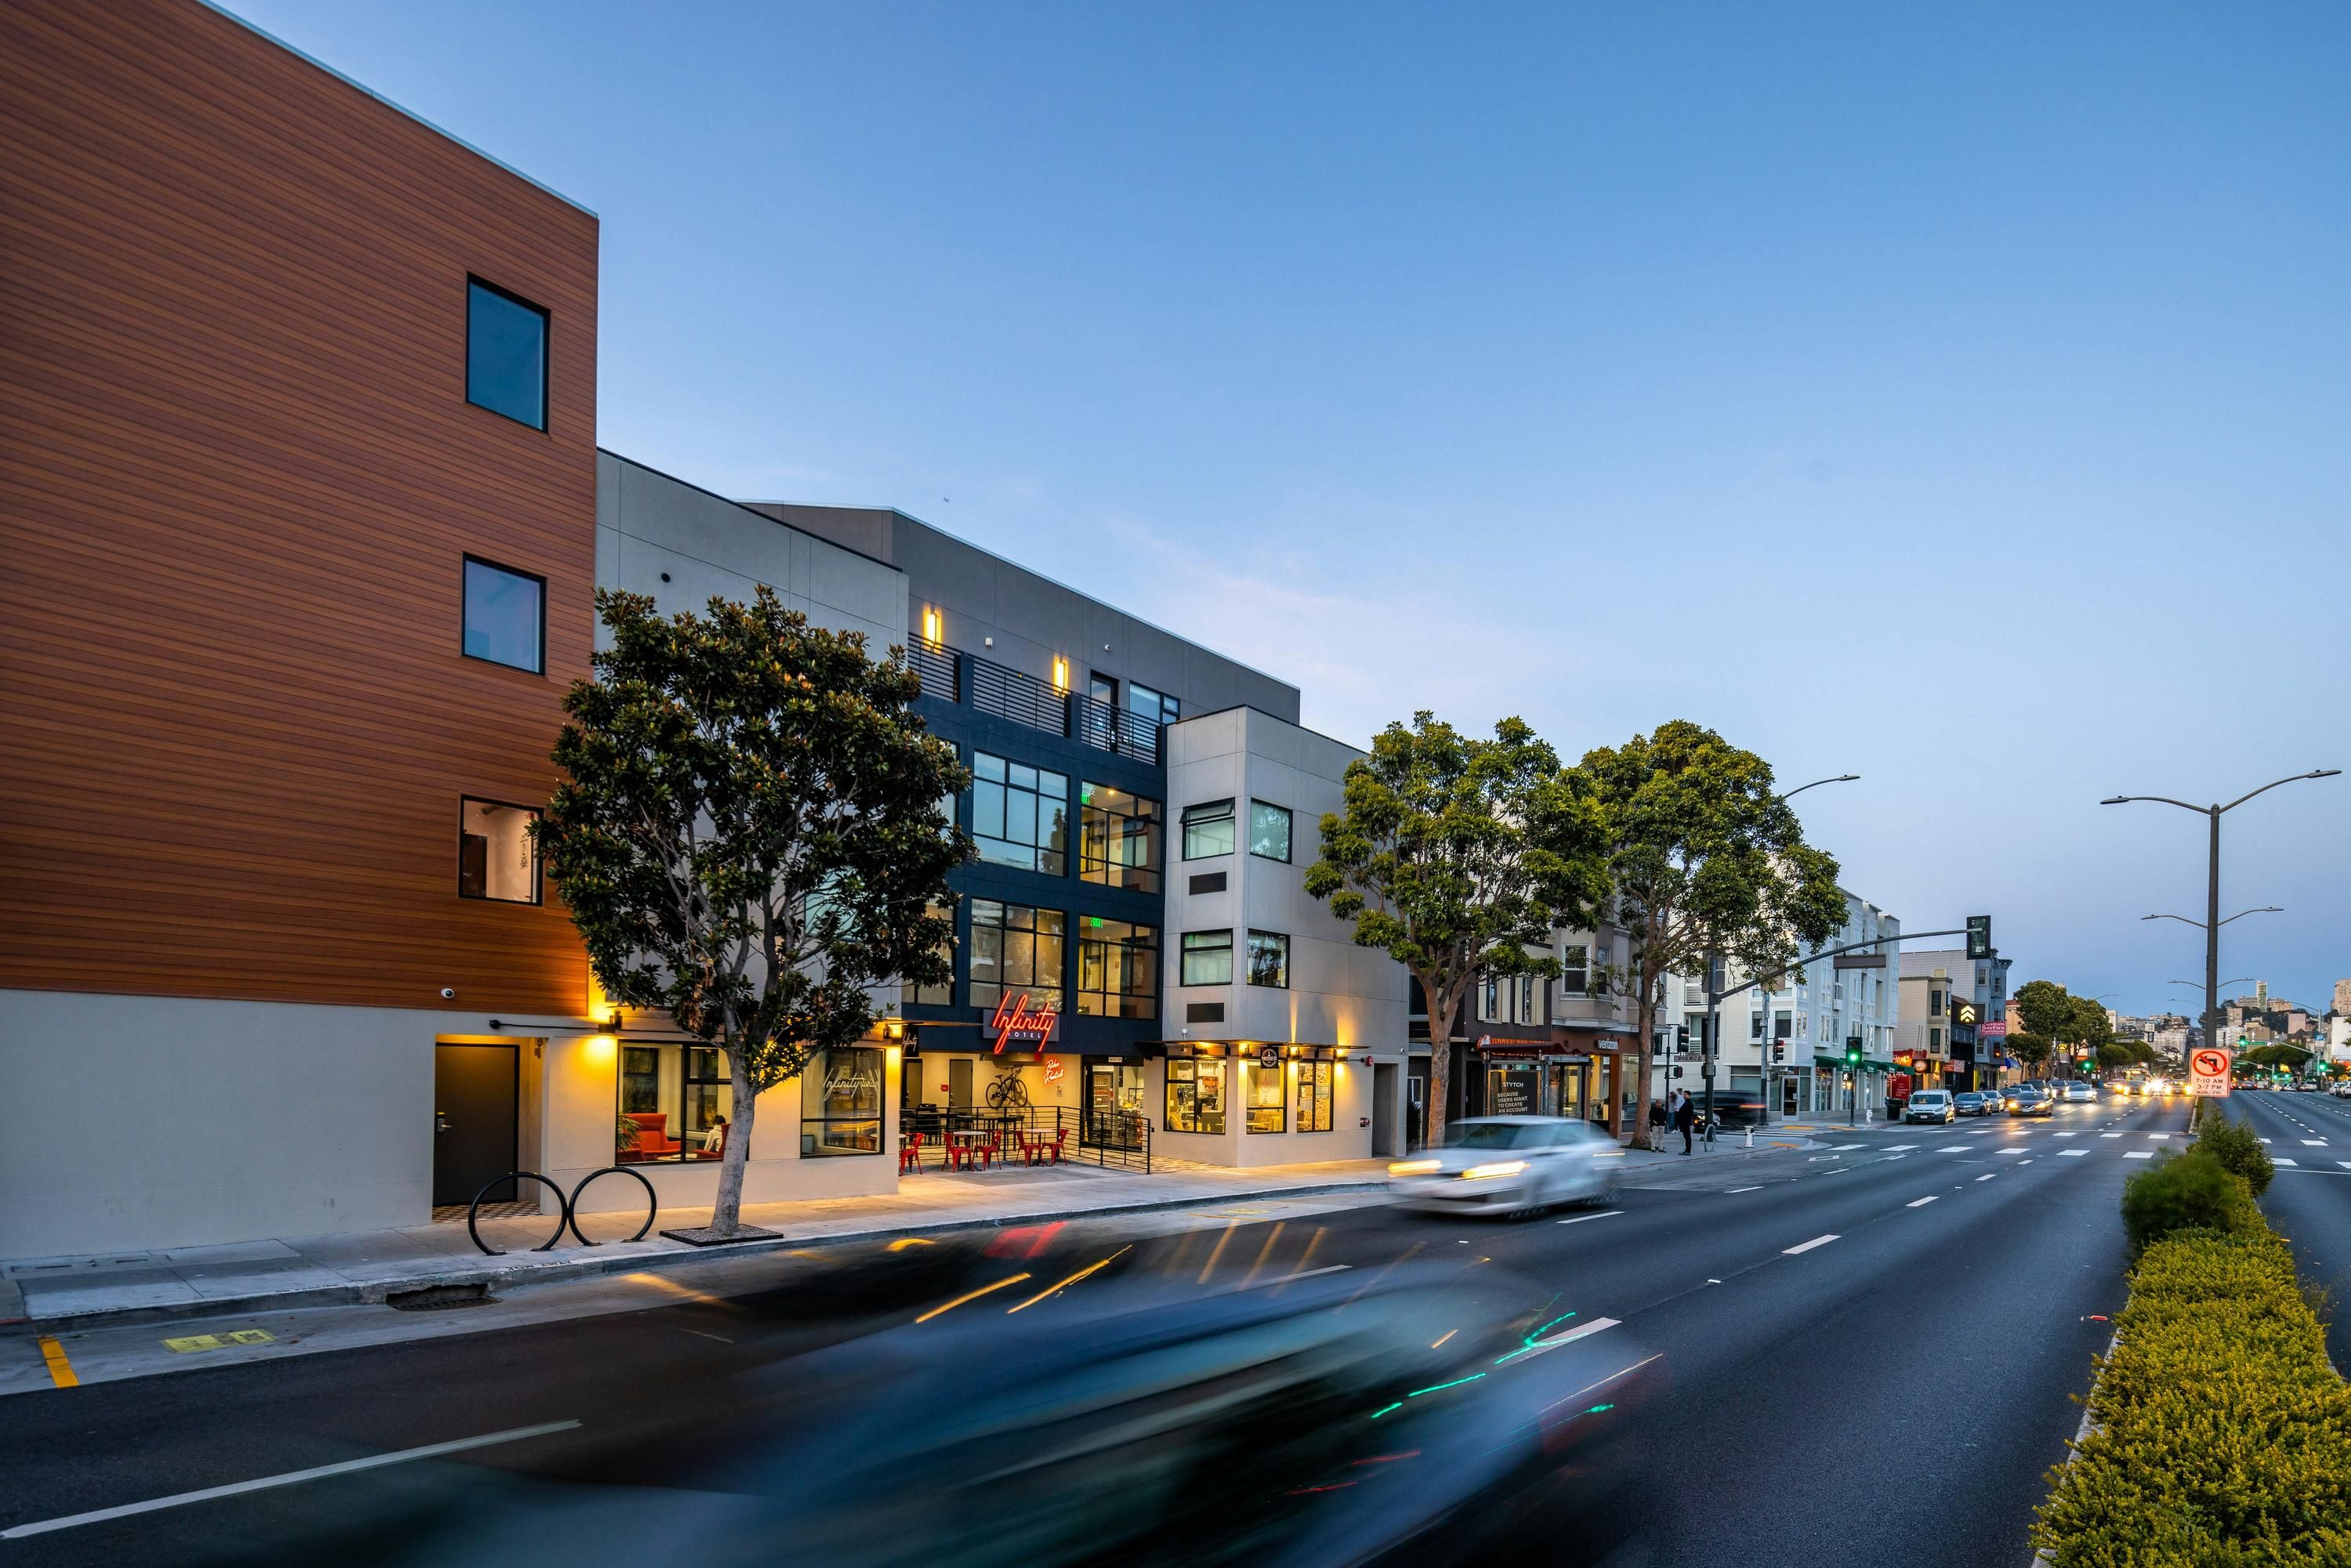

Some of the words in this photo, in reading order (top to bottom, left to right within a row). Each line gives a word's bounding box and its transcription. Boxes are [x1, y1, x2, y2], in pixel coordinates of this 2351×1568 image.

[991, 990, 1056, 1054] Infinity
[1598, 1037, 1618, 1050] verizon
[823, 1067, 864, 1102] Infinity
